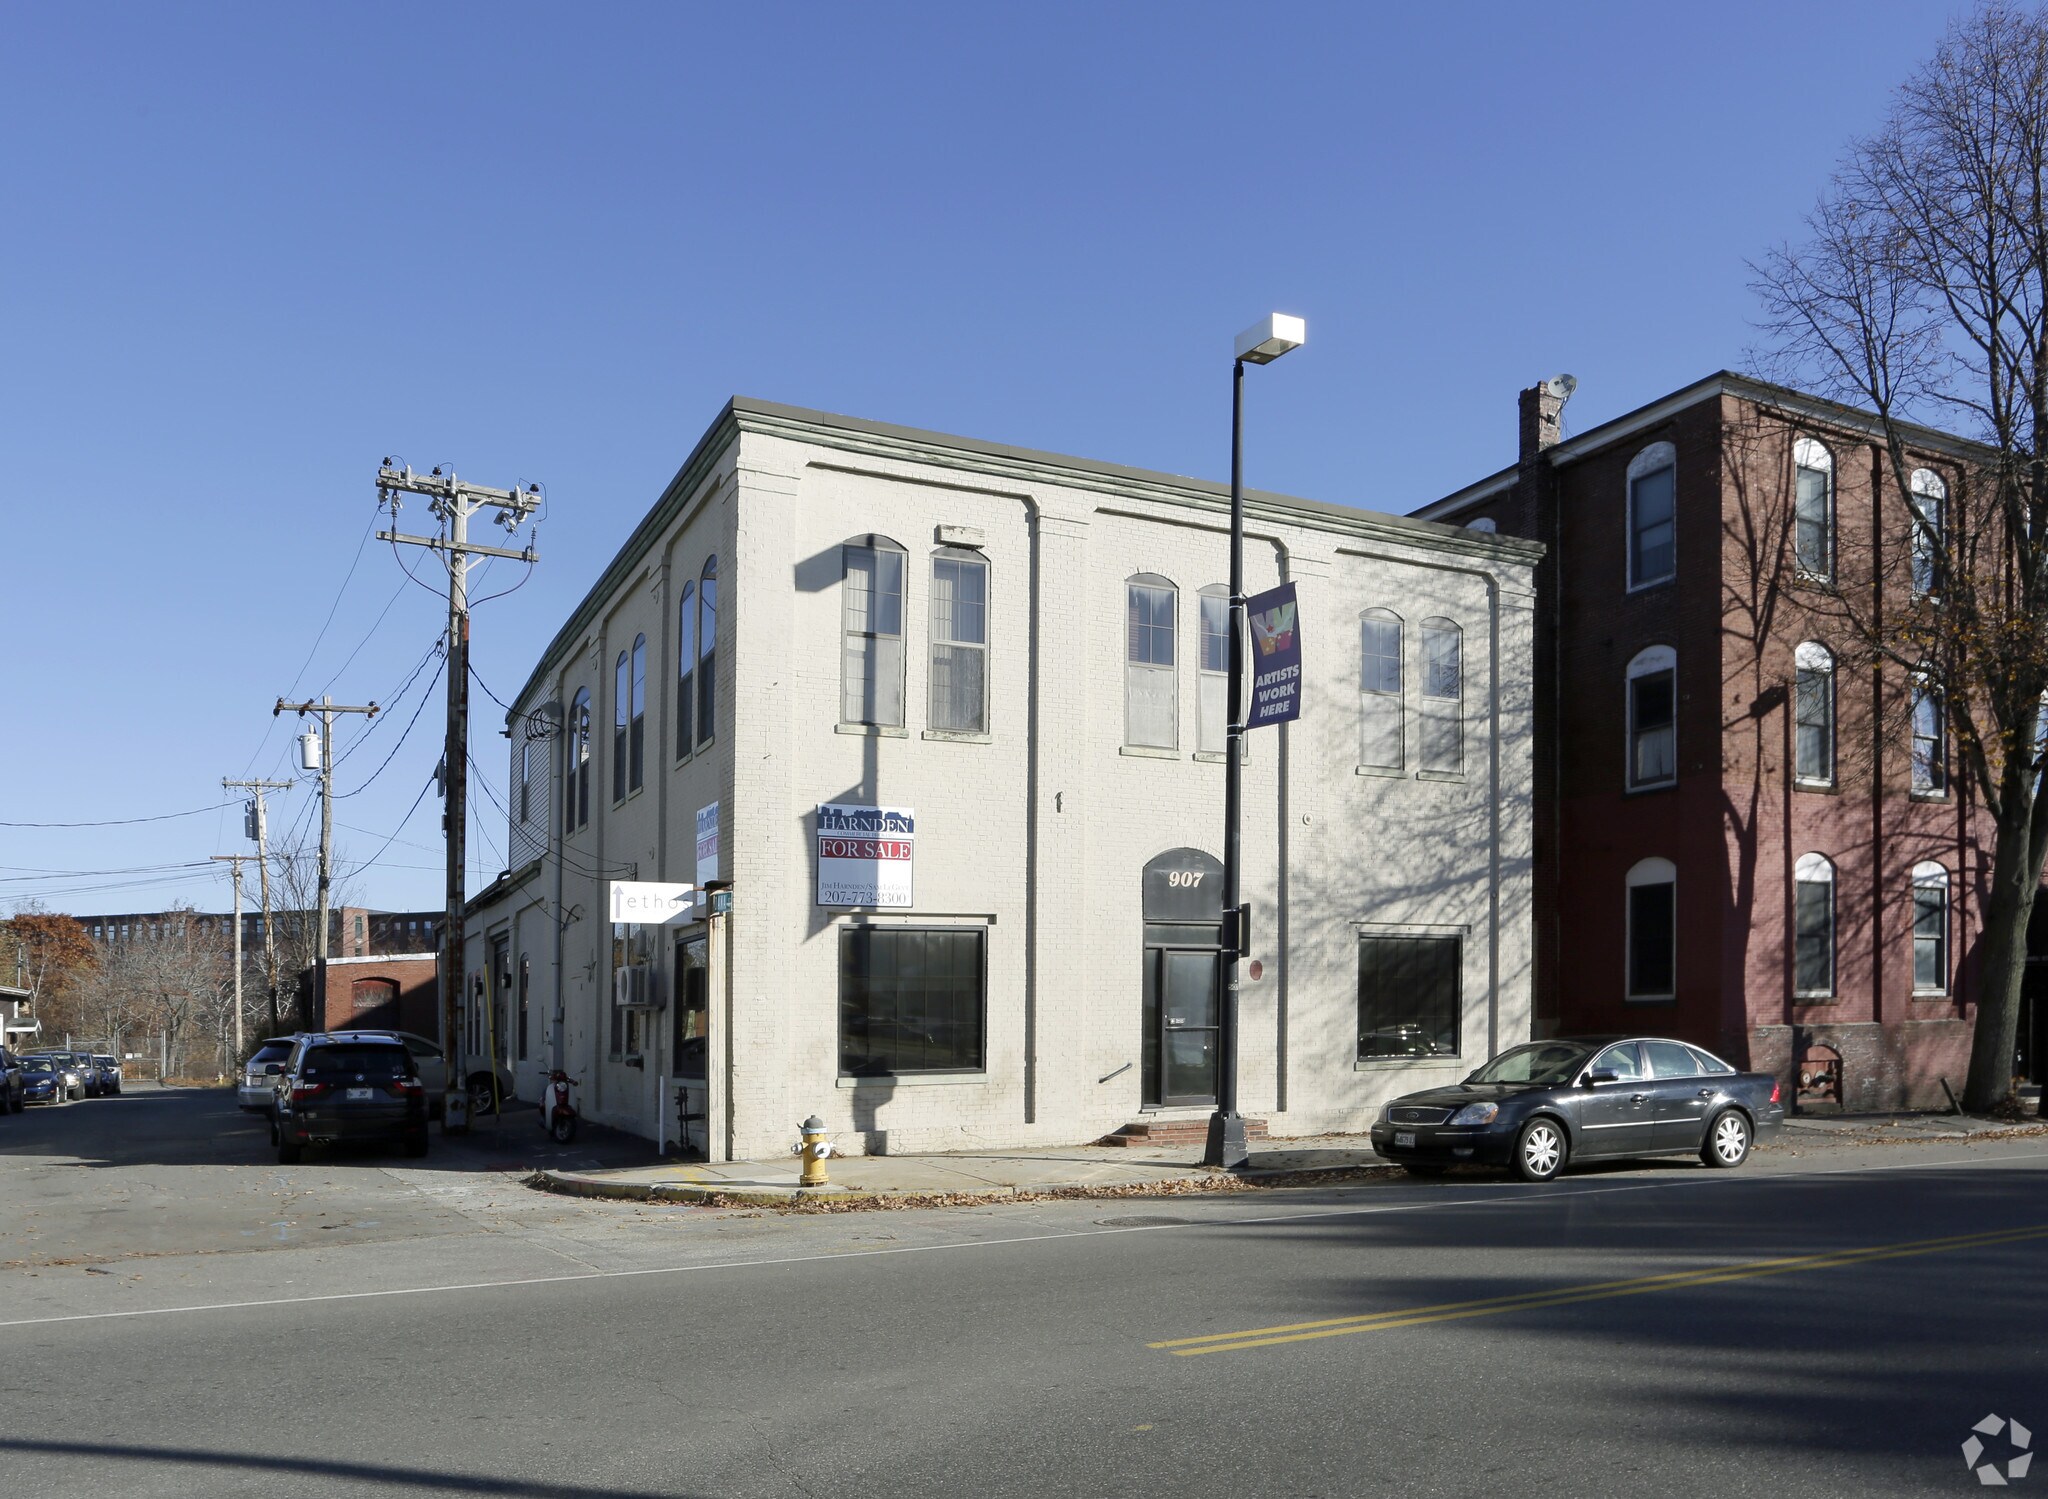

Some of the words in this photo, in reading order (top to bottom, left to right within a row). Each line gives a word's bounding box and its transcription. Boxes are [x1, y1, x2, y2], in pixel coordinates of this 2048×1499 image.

[1255, 664, 1300, 688] ARTISTS
[1258, 682, 1296, 703] WORK
[1259, 700, 1290, 718] HERE
[823, 815, 910, 833] HARNDEN
[821, 840, 859, 857] FOR
[864, 842, 911, 859] SALE
[1168, 871, 1205, 888] 907
[626, 893, 692, 910] ethos
[824, 890, 907, 904] 207-773-8300
